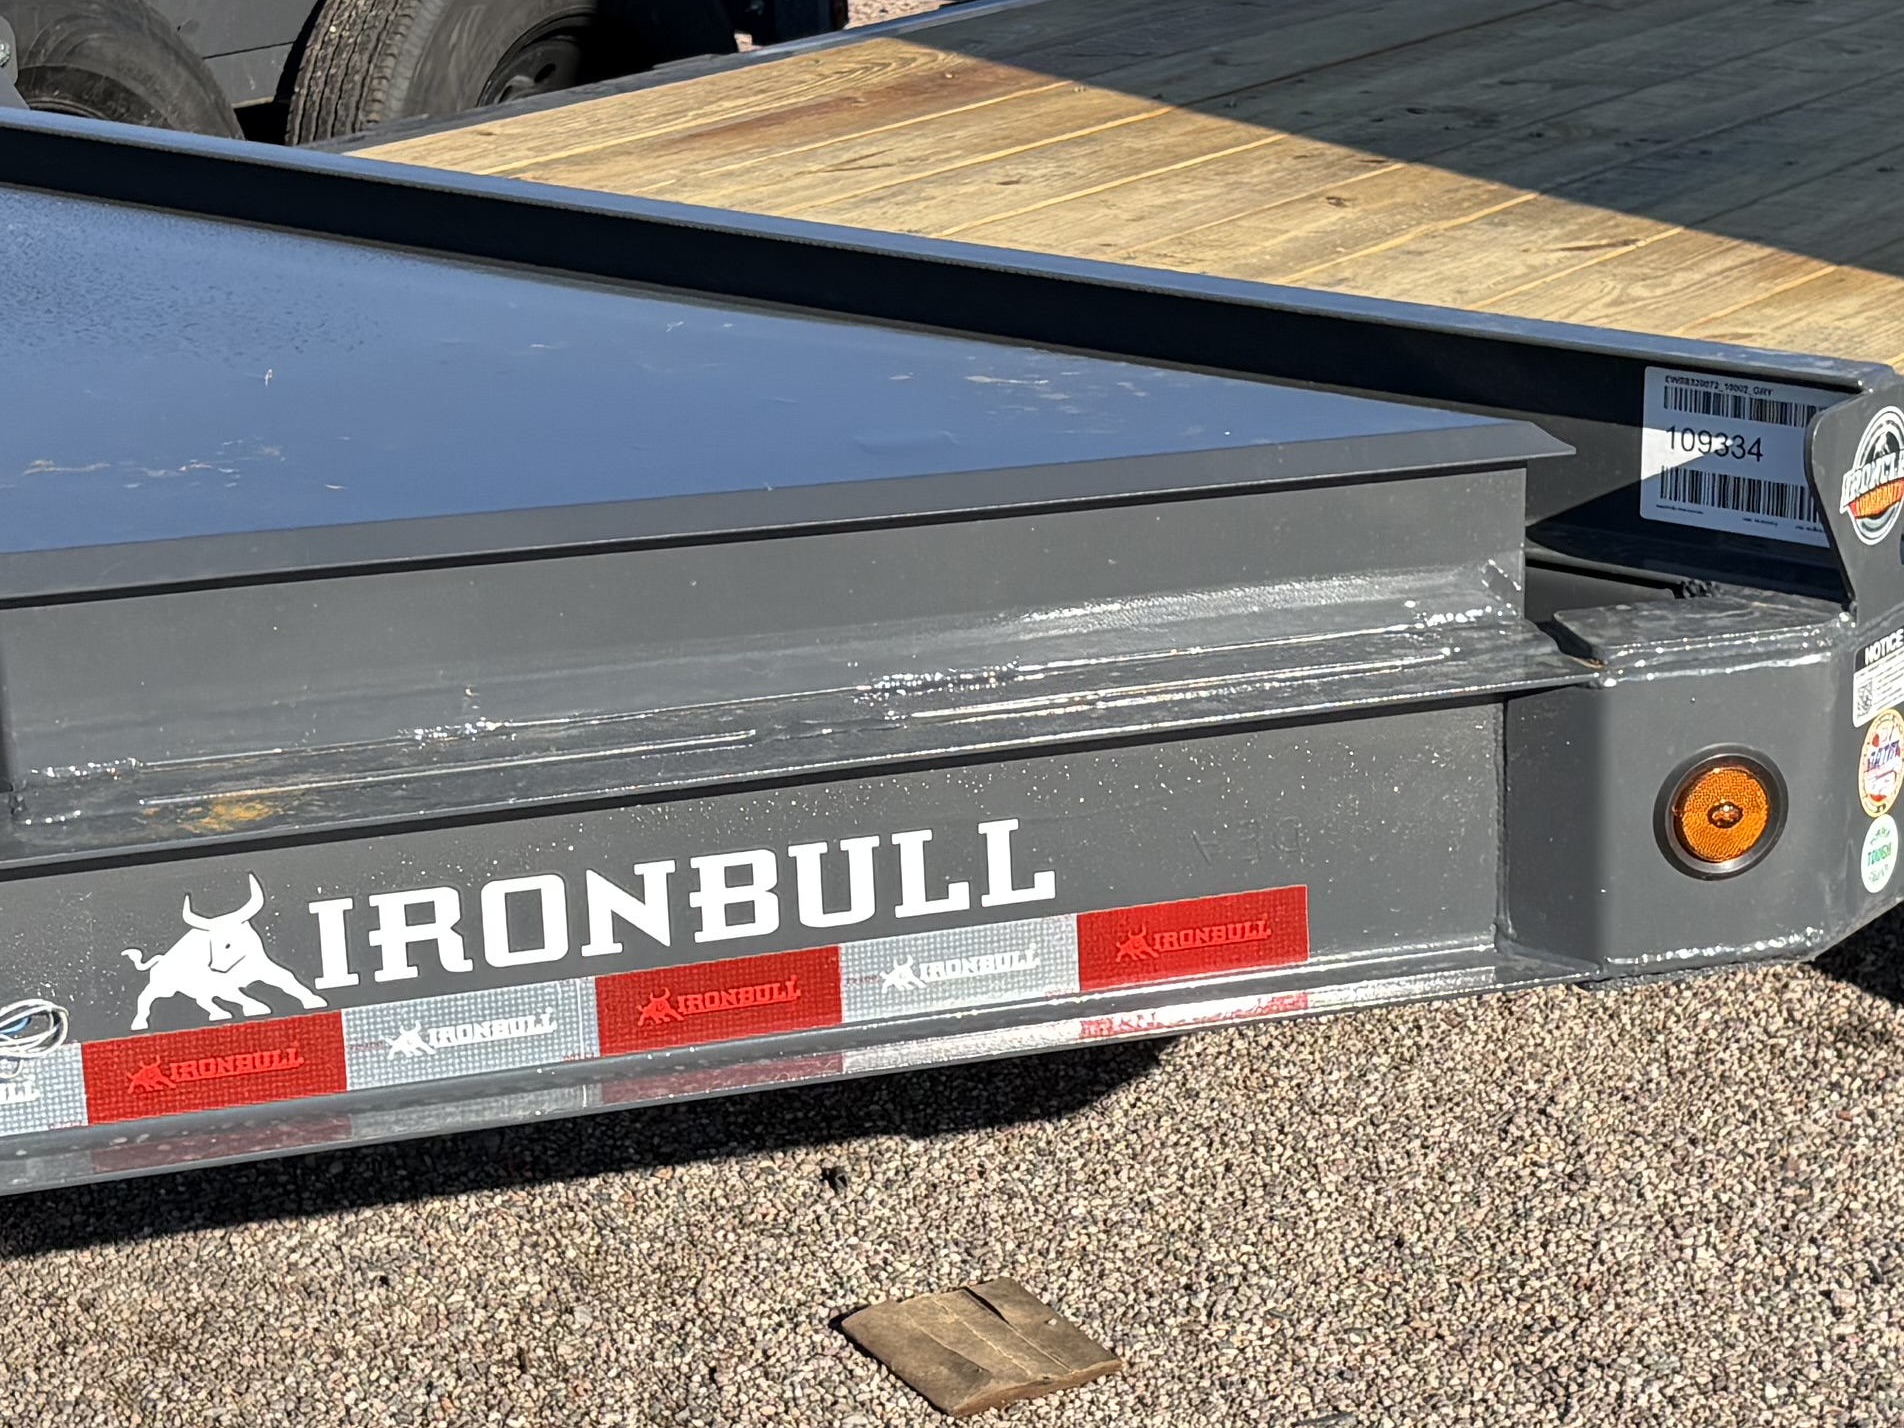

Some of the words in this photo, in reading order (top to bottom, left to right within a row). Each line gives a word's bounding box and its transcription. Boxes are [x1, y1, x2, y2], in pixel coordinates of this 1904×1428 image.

[1666, 425, 1763, 462] 109334
[1865, 628, 1904, 664] NOTICE
[308, 818, 1056, 990] IRONBULL
[1153, 920, 1272, 952] IRONBULL
[920, 947, 1041, 981] IRONBULL
[678, 979, 801, 1014] IRONBULL
[428, 1010, 558, 1048] IRONBULL
[170, 1047, 304, 1083] IRONBULL
